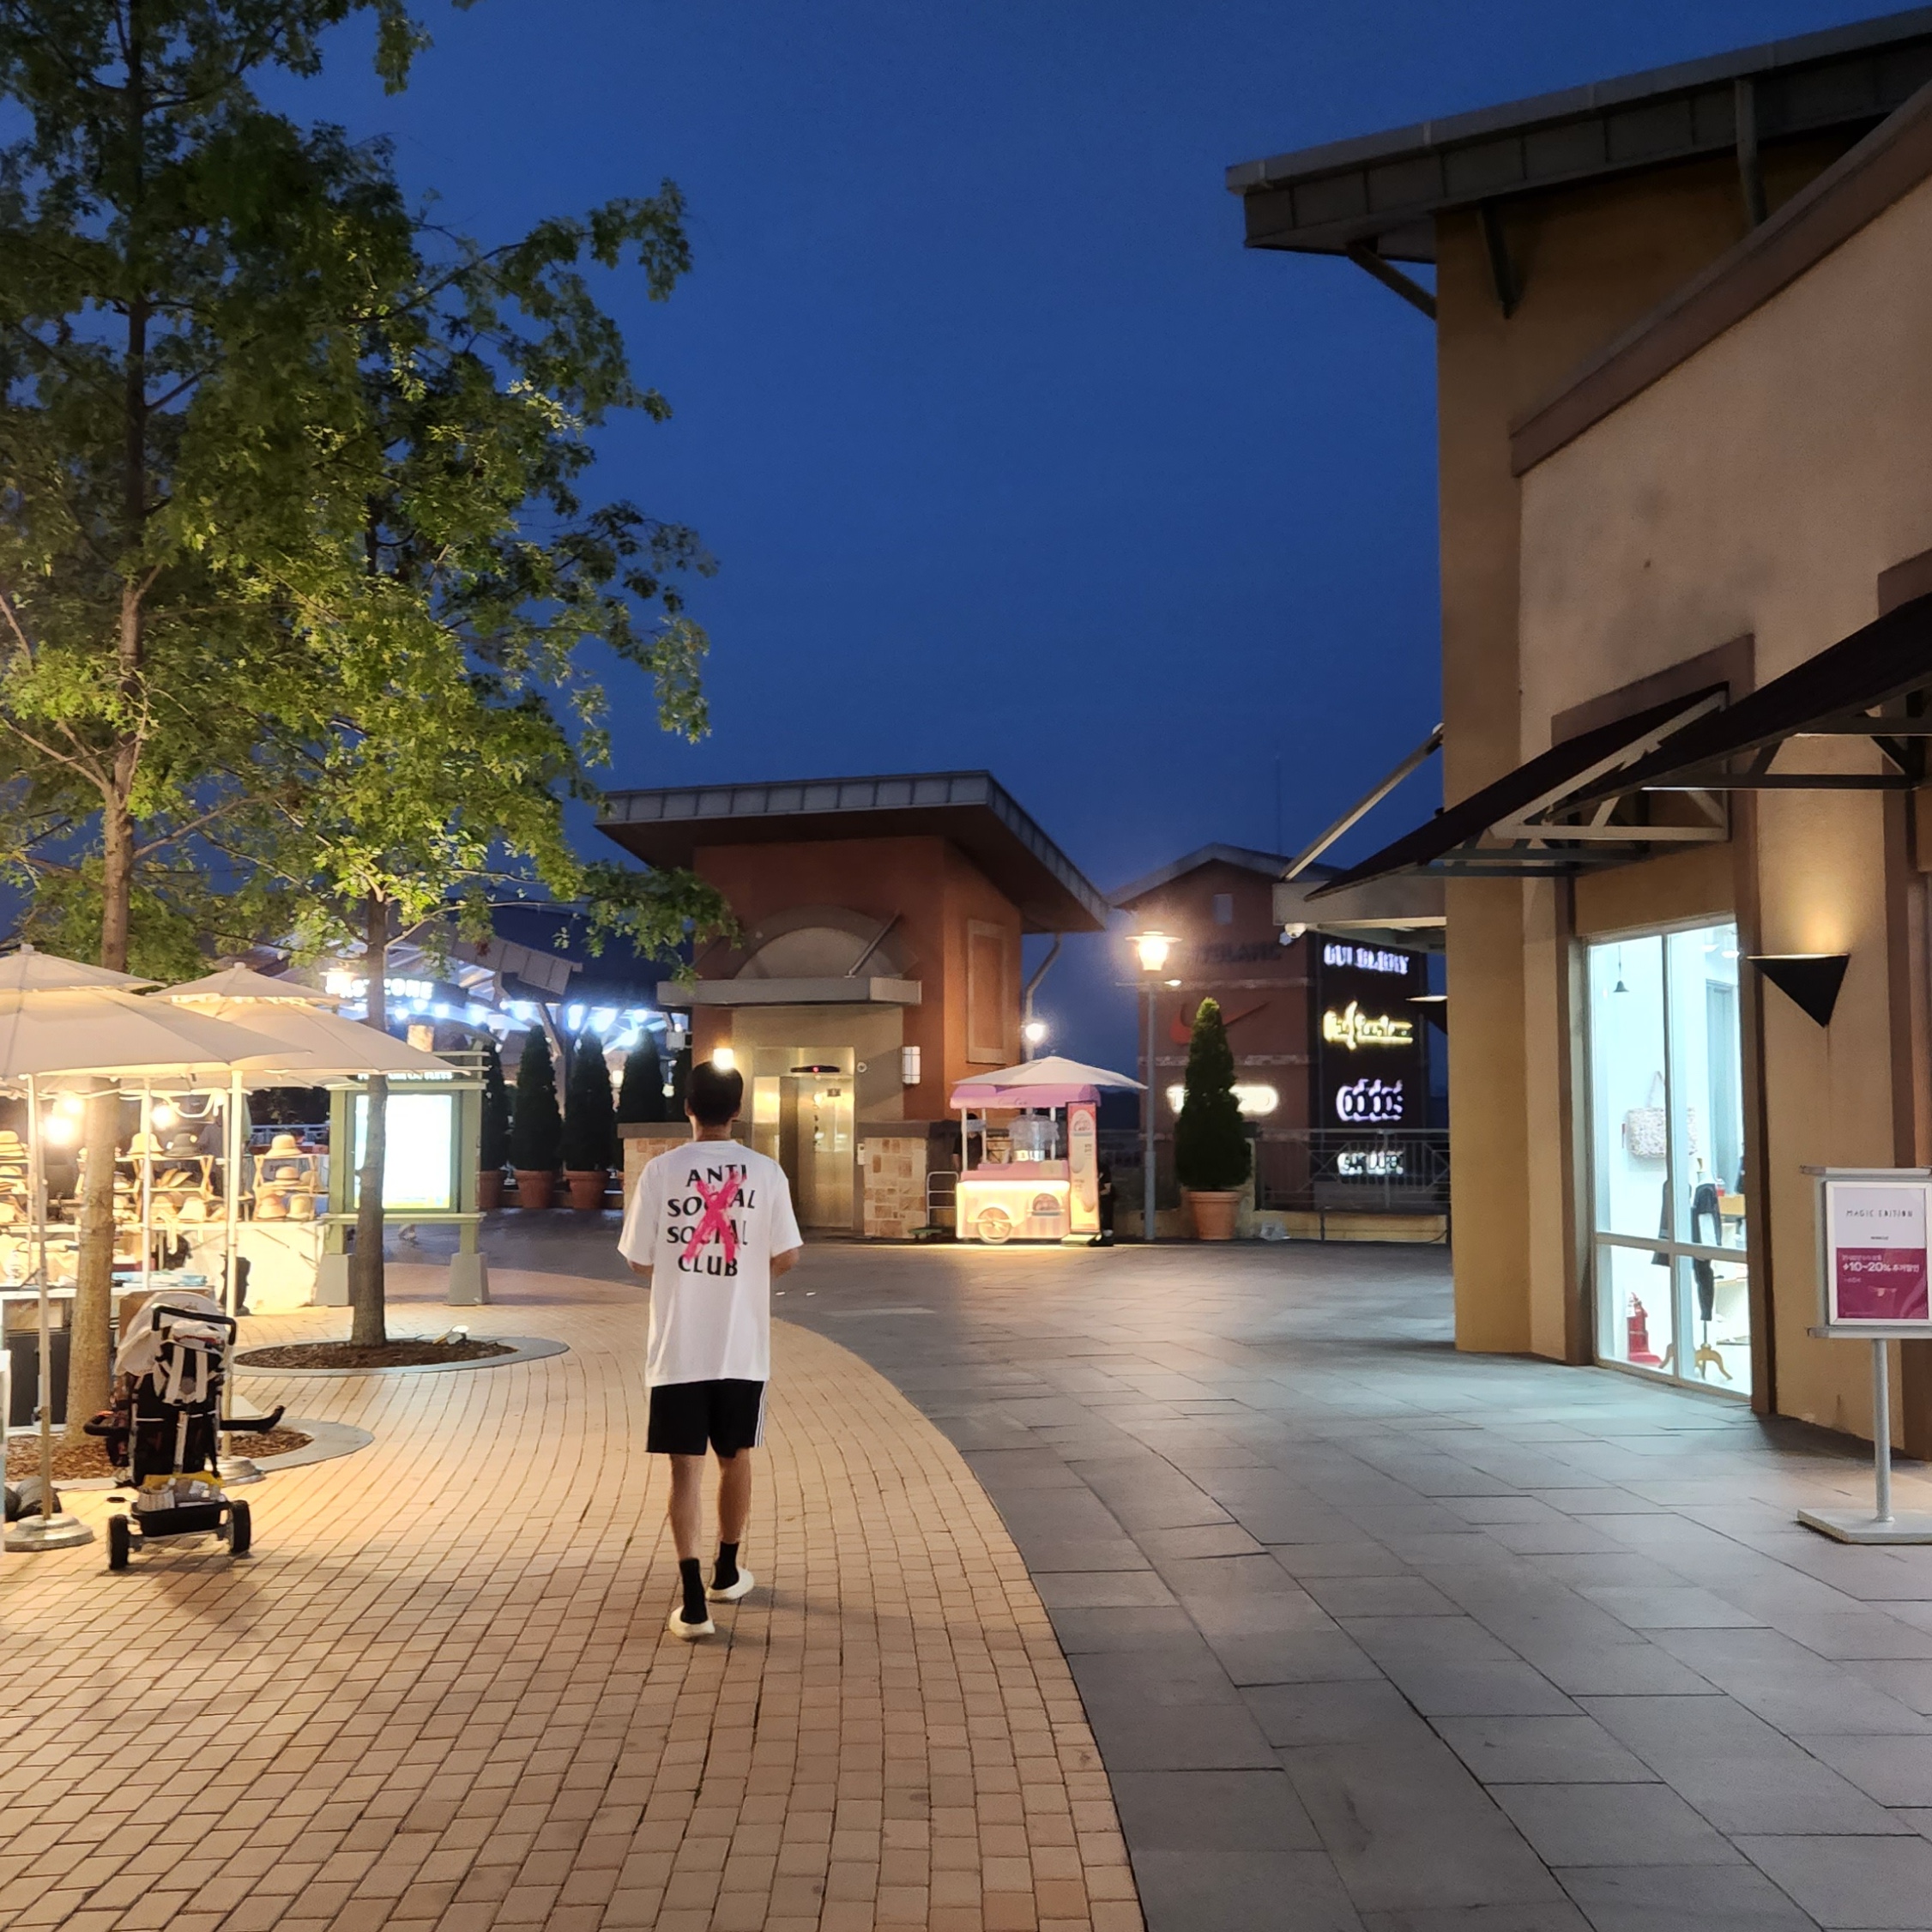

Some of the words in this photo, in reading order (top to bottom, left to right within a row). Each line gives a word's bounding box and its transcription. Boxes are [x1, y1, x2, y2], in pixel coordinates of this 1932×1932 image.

[685, 1164, 747, 1187] ANTI
[667, 1188, 756, 1217] SOAL
[678, 1254, 738, 1277] CLUB
